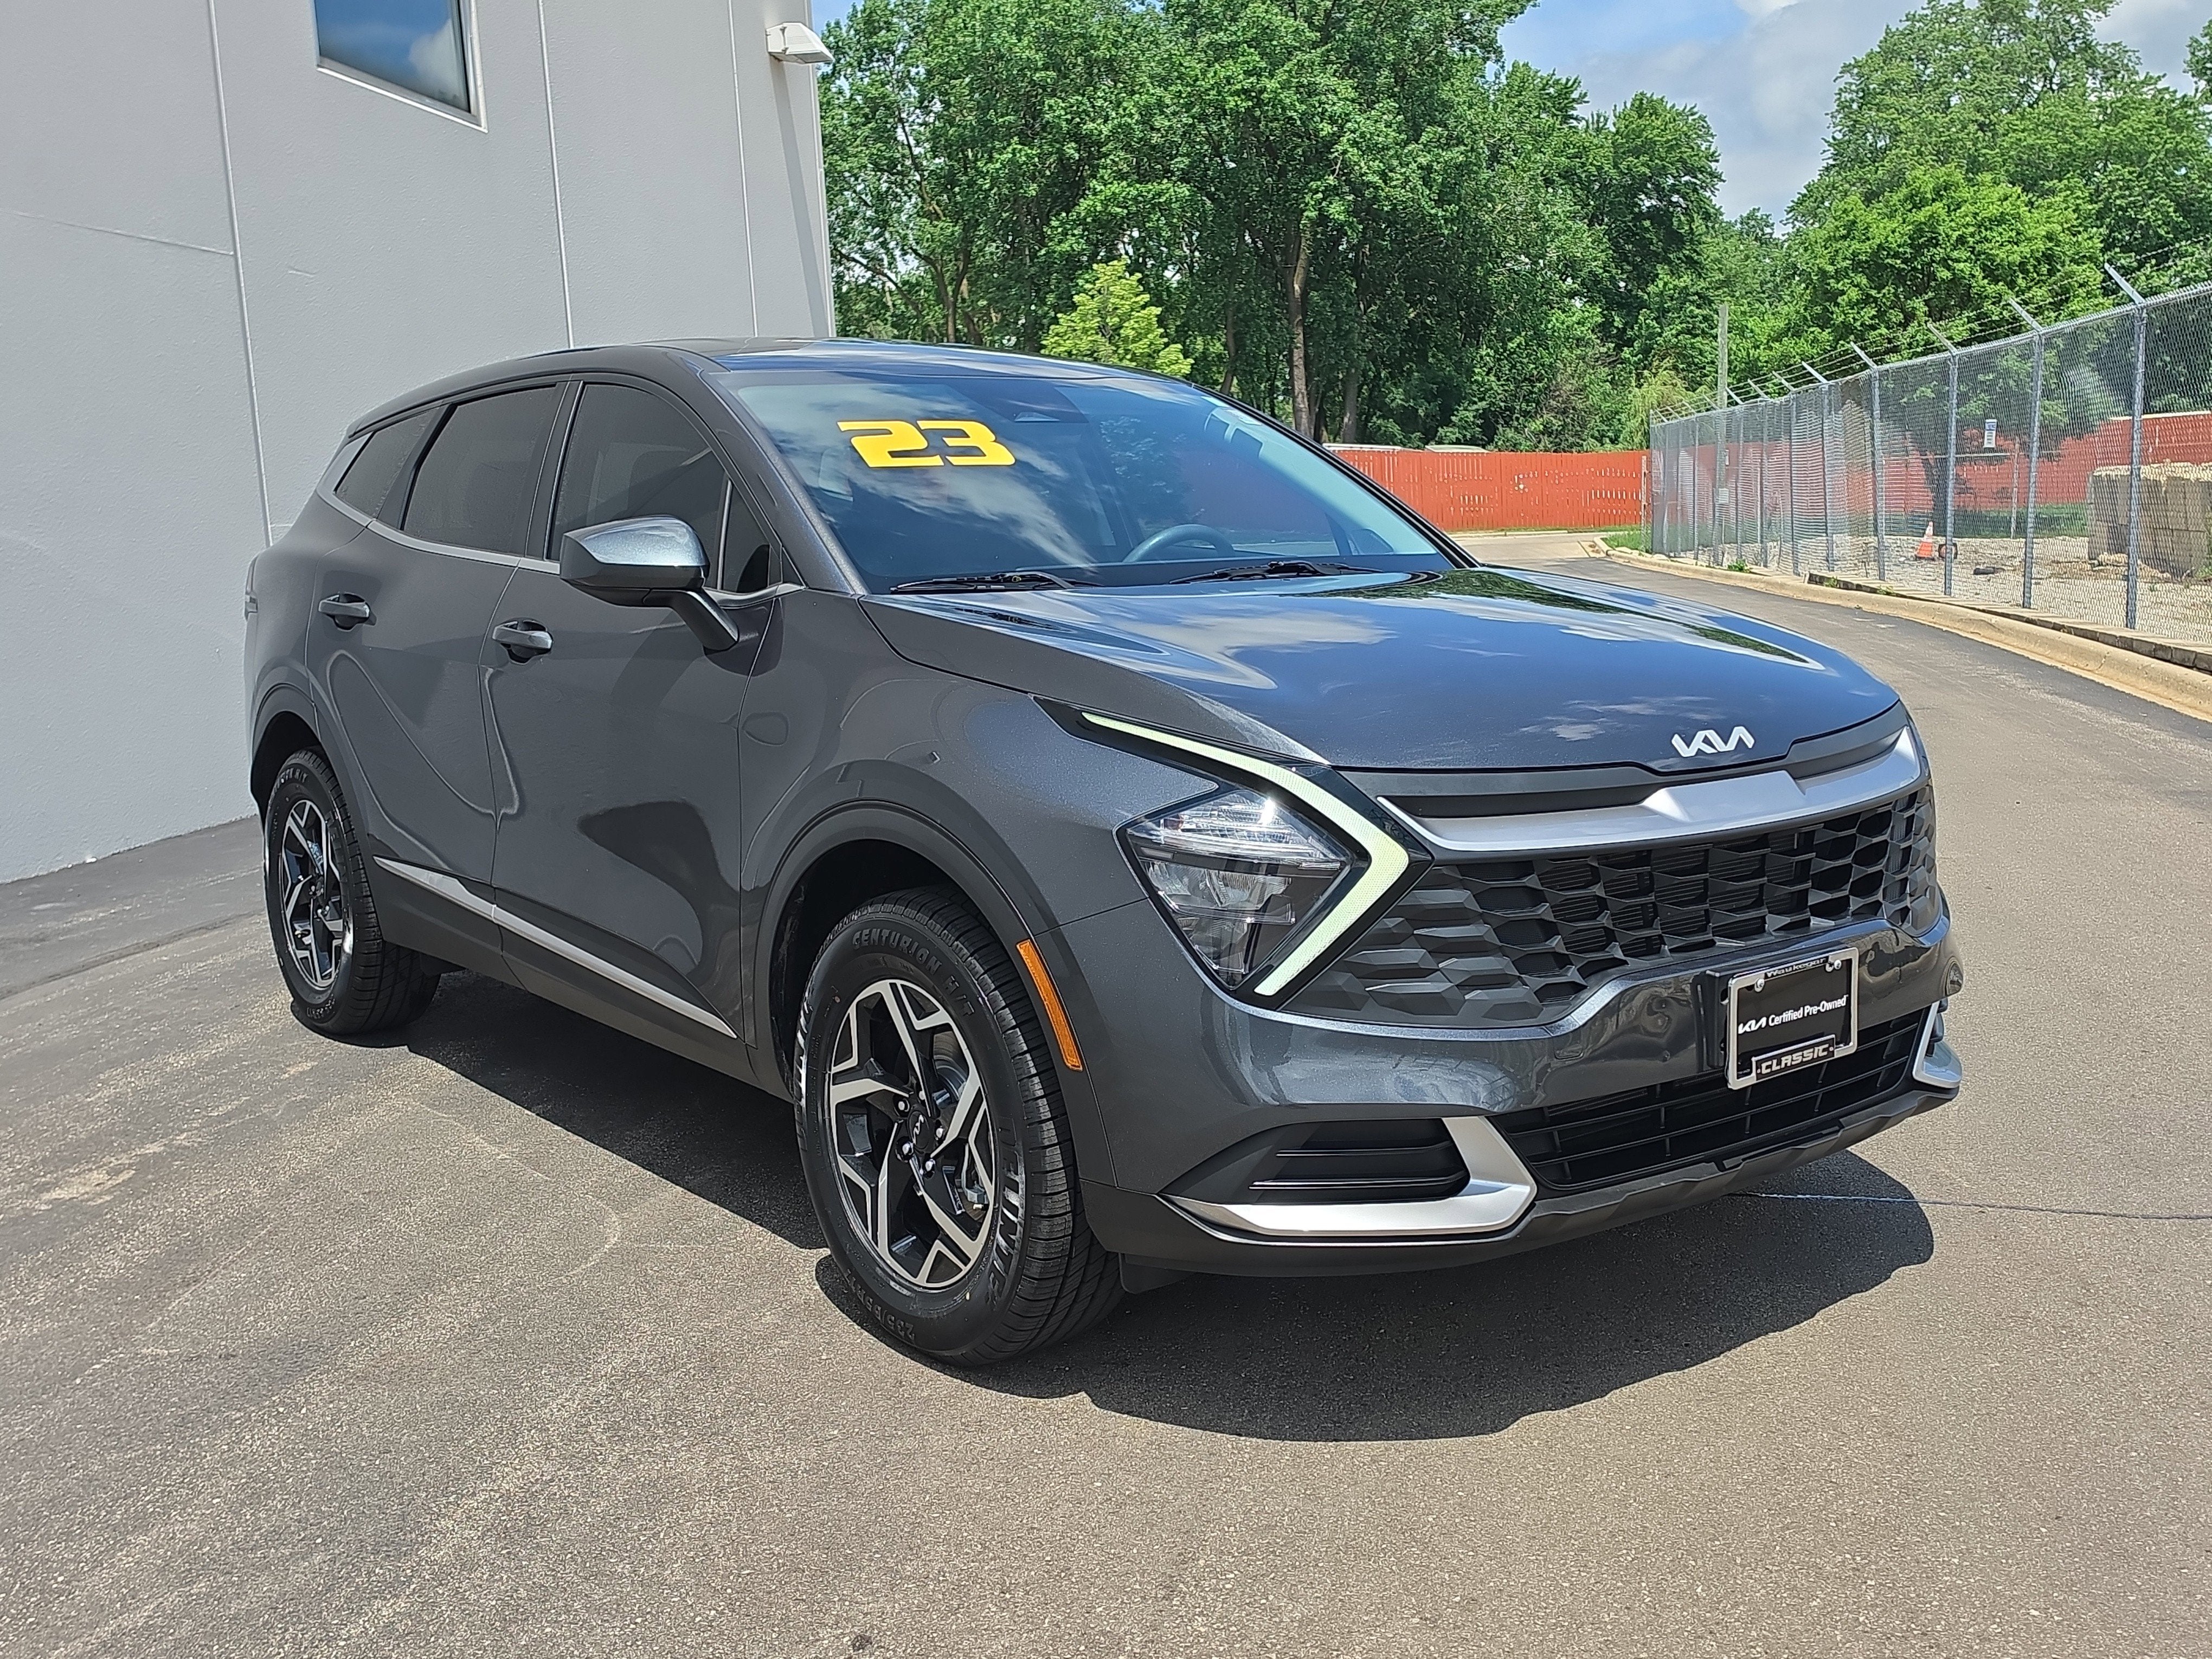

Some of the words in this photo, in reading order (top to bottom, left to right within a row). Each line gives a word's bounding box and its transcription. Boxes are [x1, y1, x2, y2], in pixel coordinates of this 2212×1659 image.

[837, 420, 1017, 468] 23
[1671, 726, 1755, 757] KIA
[852, 928, 943, 975] CENTURION
[944, 975, 975, 1017] H/T
[1738, 1017, 1767, 1034] KIA
[1769, 1007, 1804, 1026] Certified
[1804, 996, 1847, 1017] Pre-Owned
[1761, 1043, 1829, 1075] CLASSIC
